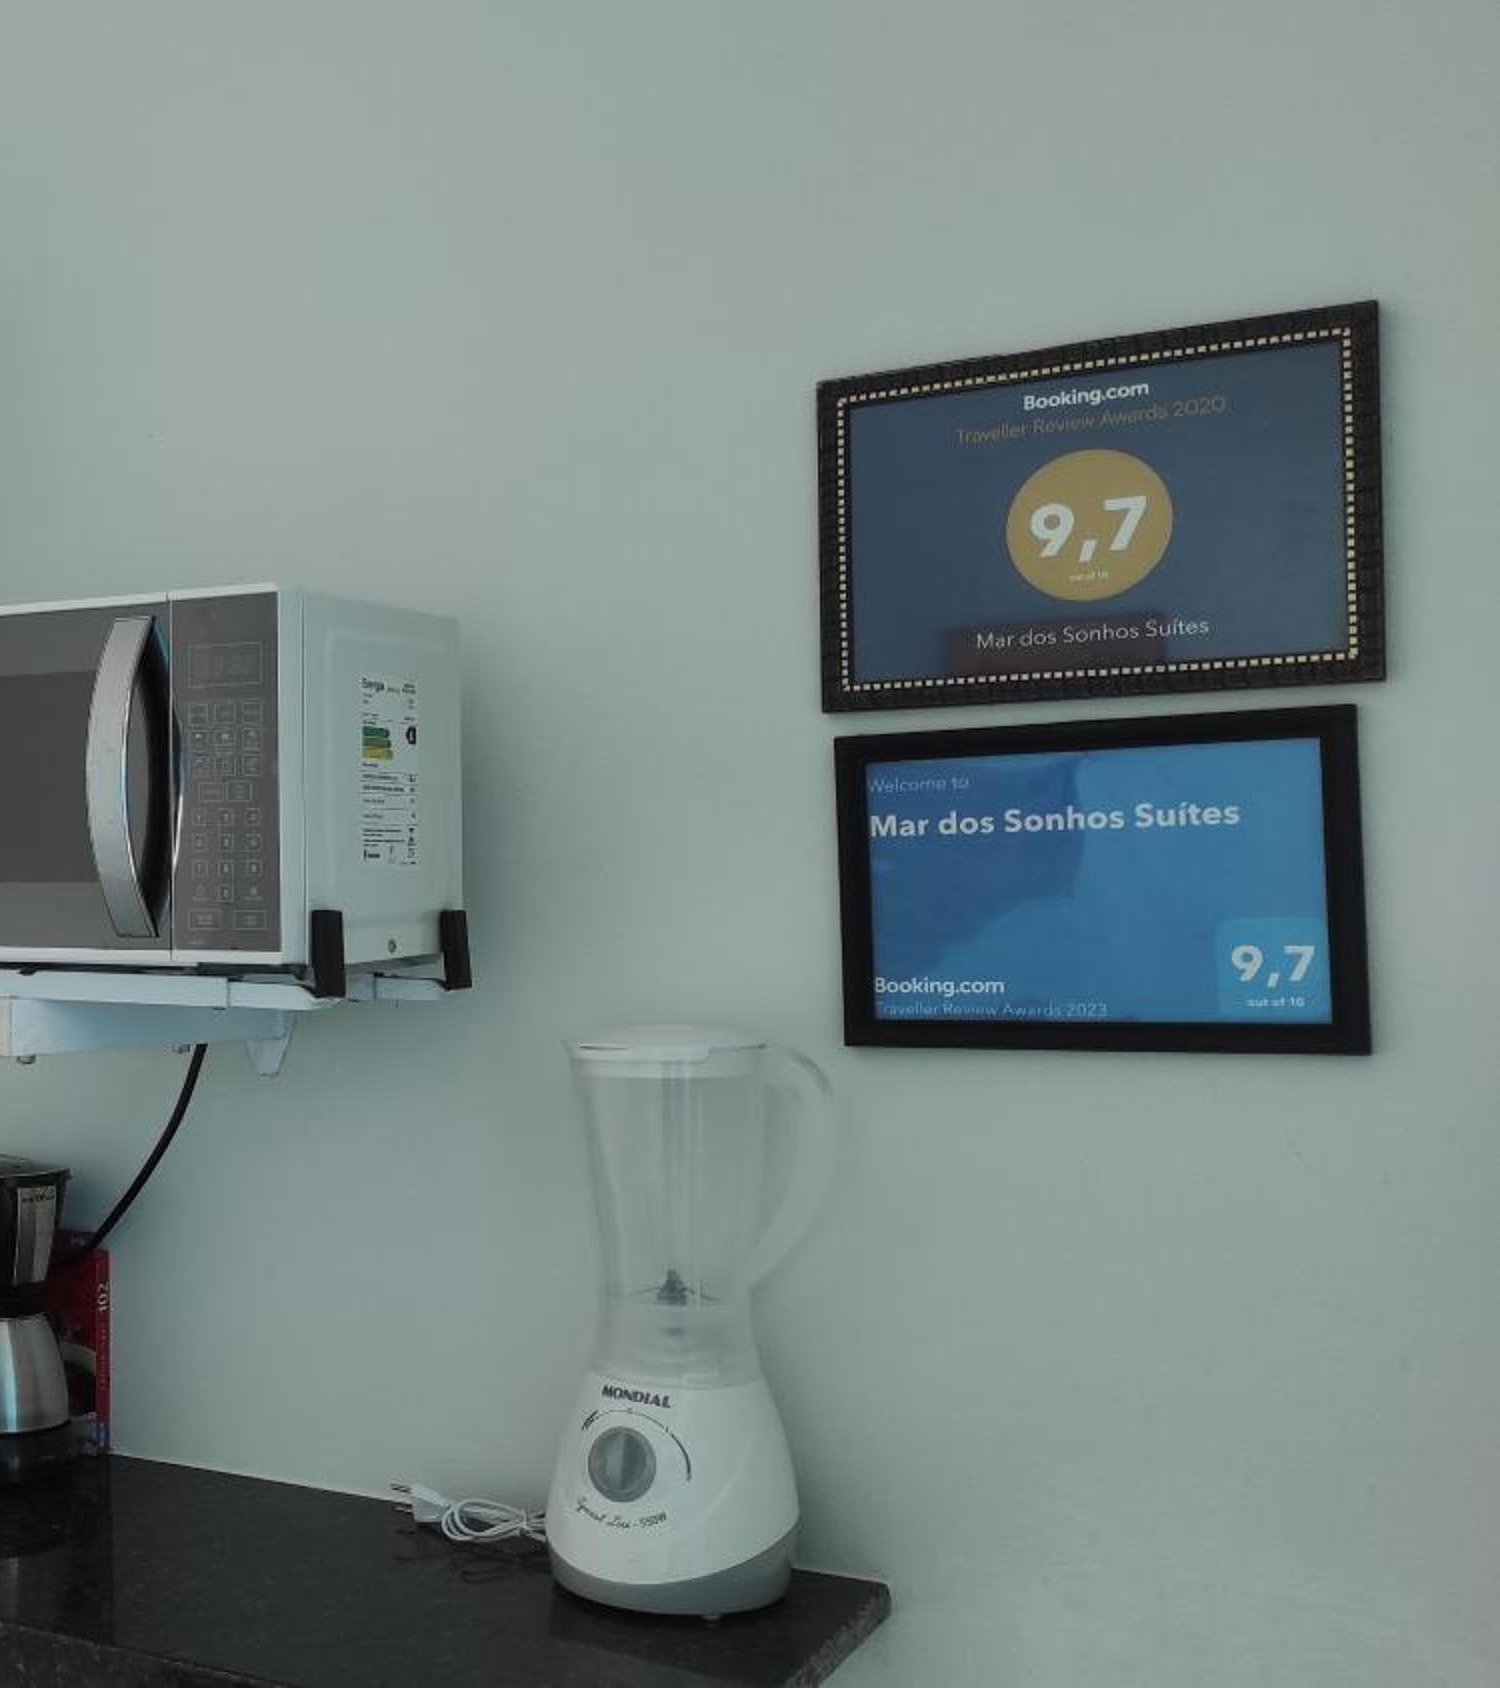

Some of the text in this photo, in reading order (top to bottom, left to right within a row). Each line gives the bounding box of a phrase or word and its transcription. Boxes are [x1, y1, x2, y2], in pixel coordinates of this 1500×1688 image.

[1023, 383, 1149, 411] Booking.com
[956, 396, 1227, 445] Traveller Review Awards 2020
[1030, 495, 1148, 564] 9,7
[976, 617, 1210, 650] Mar dos Sonhos Suítes
[868, 776, 970, 793] Welcome to
[870, 801, 1241, 837] Mar dos Sonhos Suítes
[1231, 944, 1316, 988] 9,7
[875, 977, 1005, 997] Booking.com
[942, 1001, 998, 1016] Review
[1002, 1001, 1061, 1017] Awards
[1062, 1002, 1108, 1018] 2023
[1290, 996, 1306, 1008] 10
[602, 1384, 671, 1409] MONDIAL
